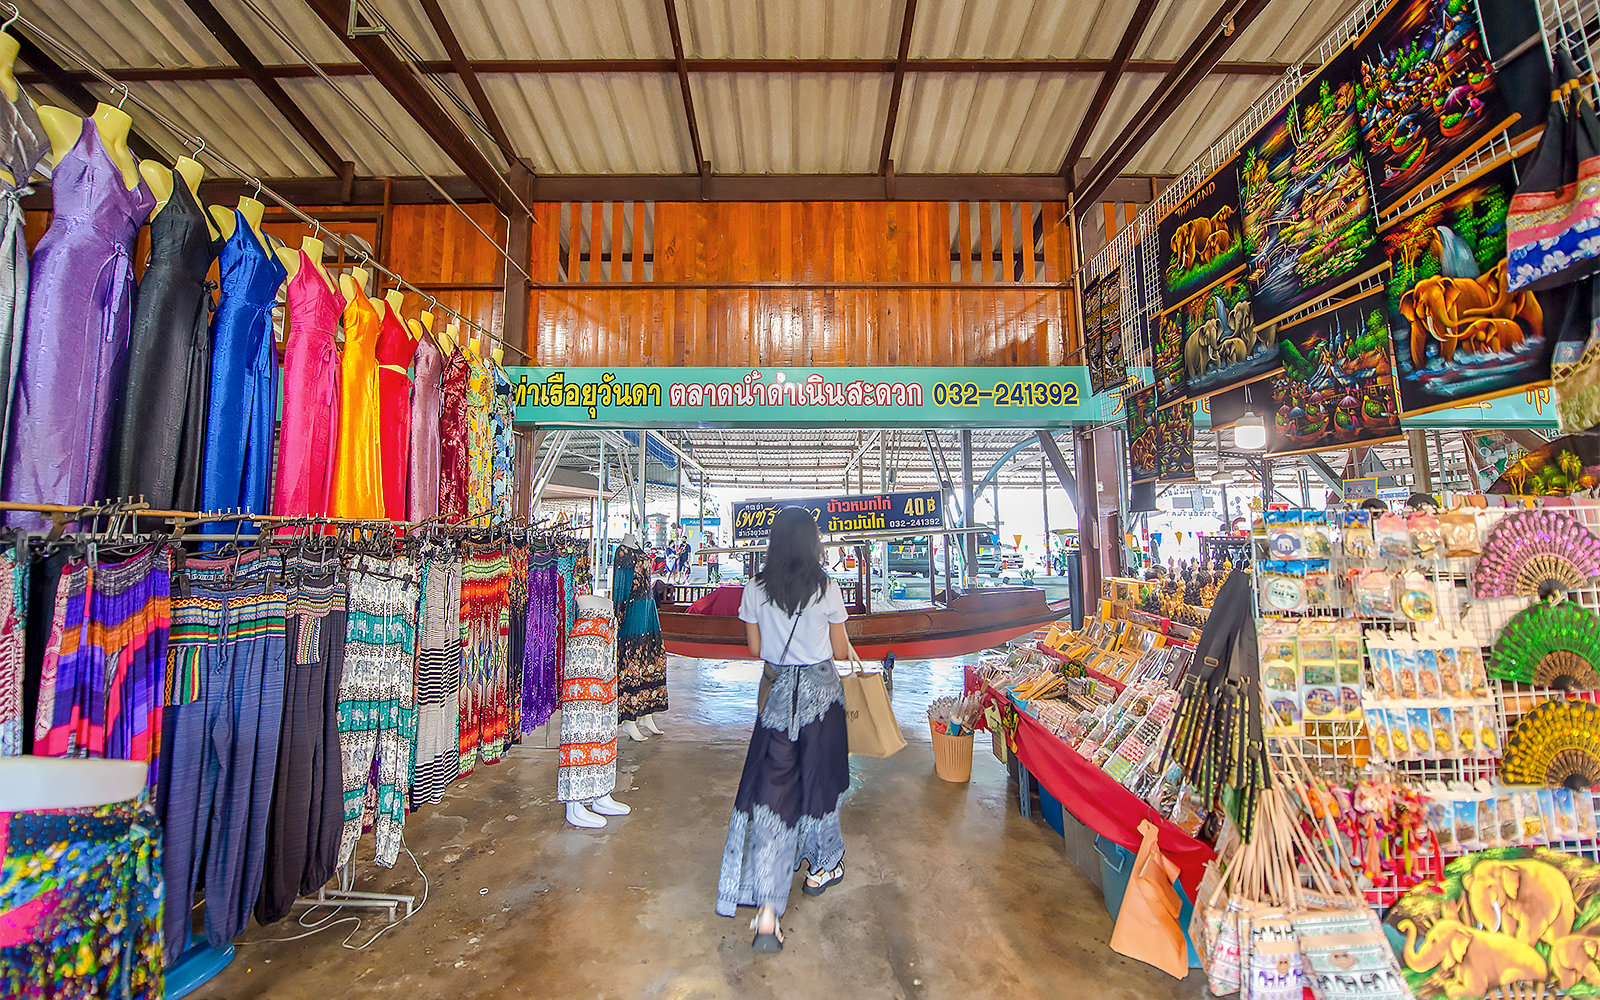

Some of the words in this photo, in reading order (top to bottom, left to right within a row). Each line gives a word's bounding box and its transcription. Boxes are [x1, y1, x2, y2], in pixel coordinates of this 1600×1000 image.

[1174, 181, 1216, 218] THAILAND
[514, 371, 662, 419] ท่าเรือยุวันดา
[669, 369, 924, 408] ตลาดน้ำดำเนินสะดวก
[932, 381, 1080, 407] 032-241392
[826, 495, 892, 513] ข้าวหมกไก่
[828, 511, 886, 531] ข้าวมันไก่
[889, 517, 941, 528] 032-241392
